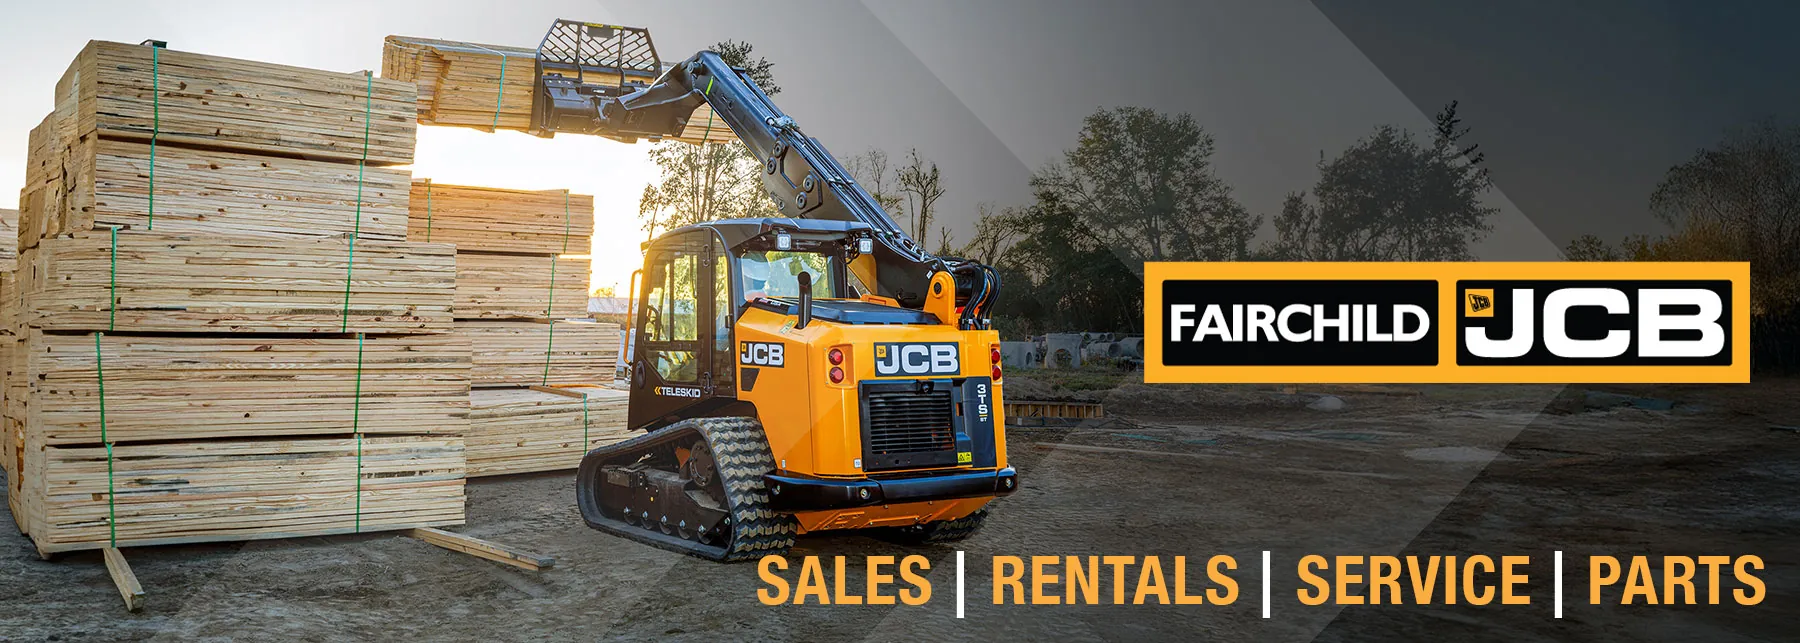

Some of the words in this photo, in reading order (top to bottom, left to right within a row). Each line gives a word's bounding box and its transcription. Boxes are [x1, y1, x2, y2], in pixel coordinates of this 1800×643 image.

[741, 343, 784, 366] JCB
[876, 344, 958, 374] JCB
[661, 386, 701, 398] TELESKID
